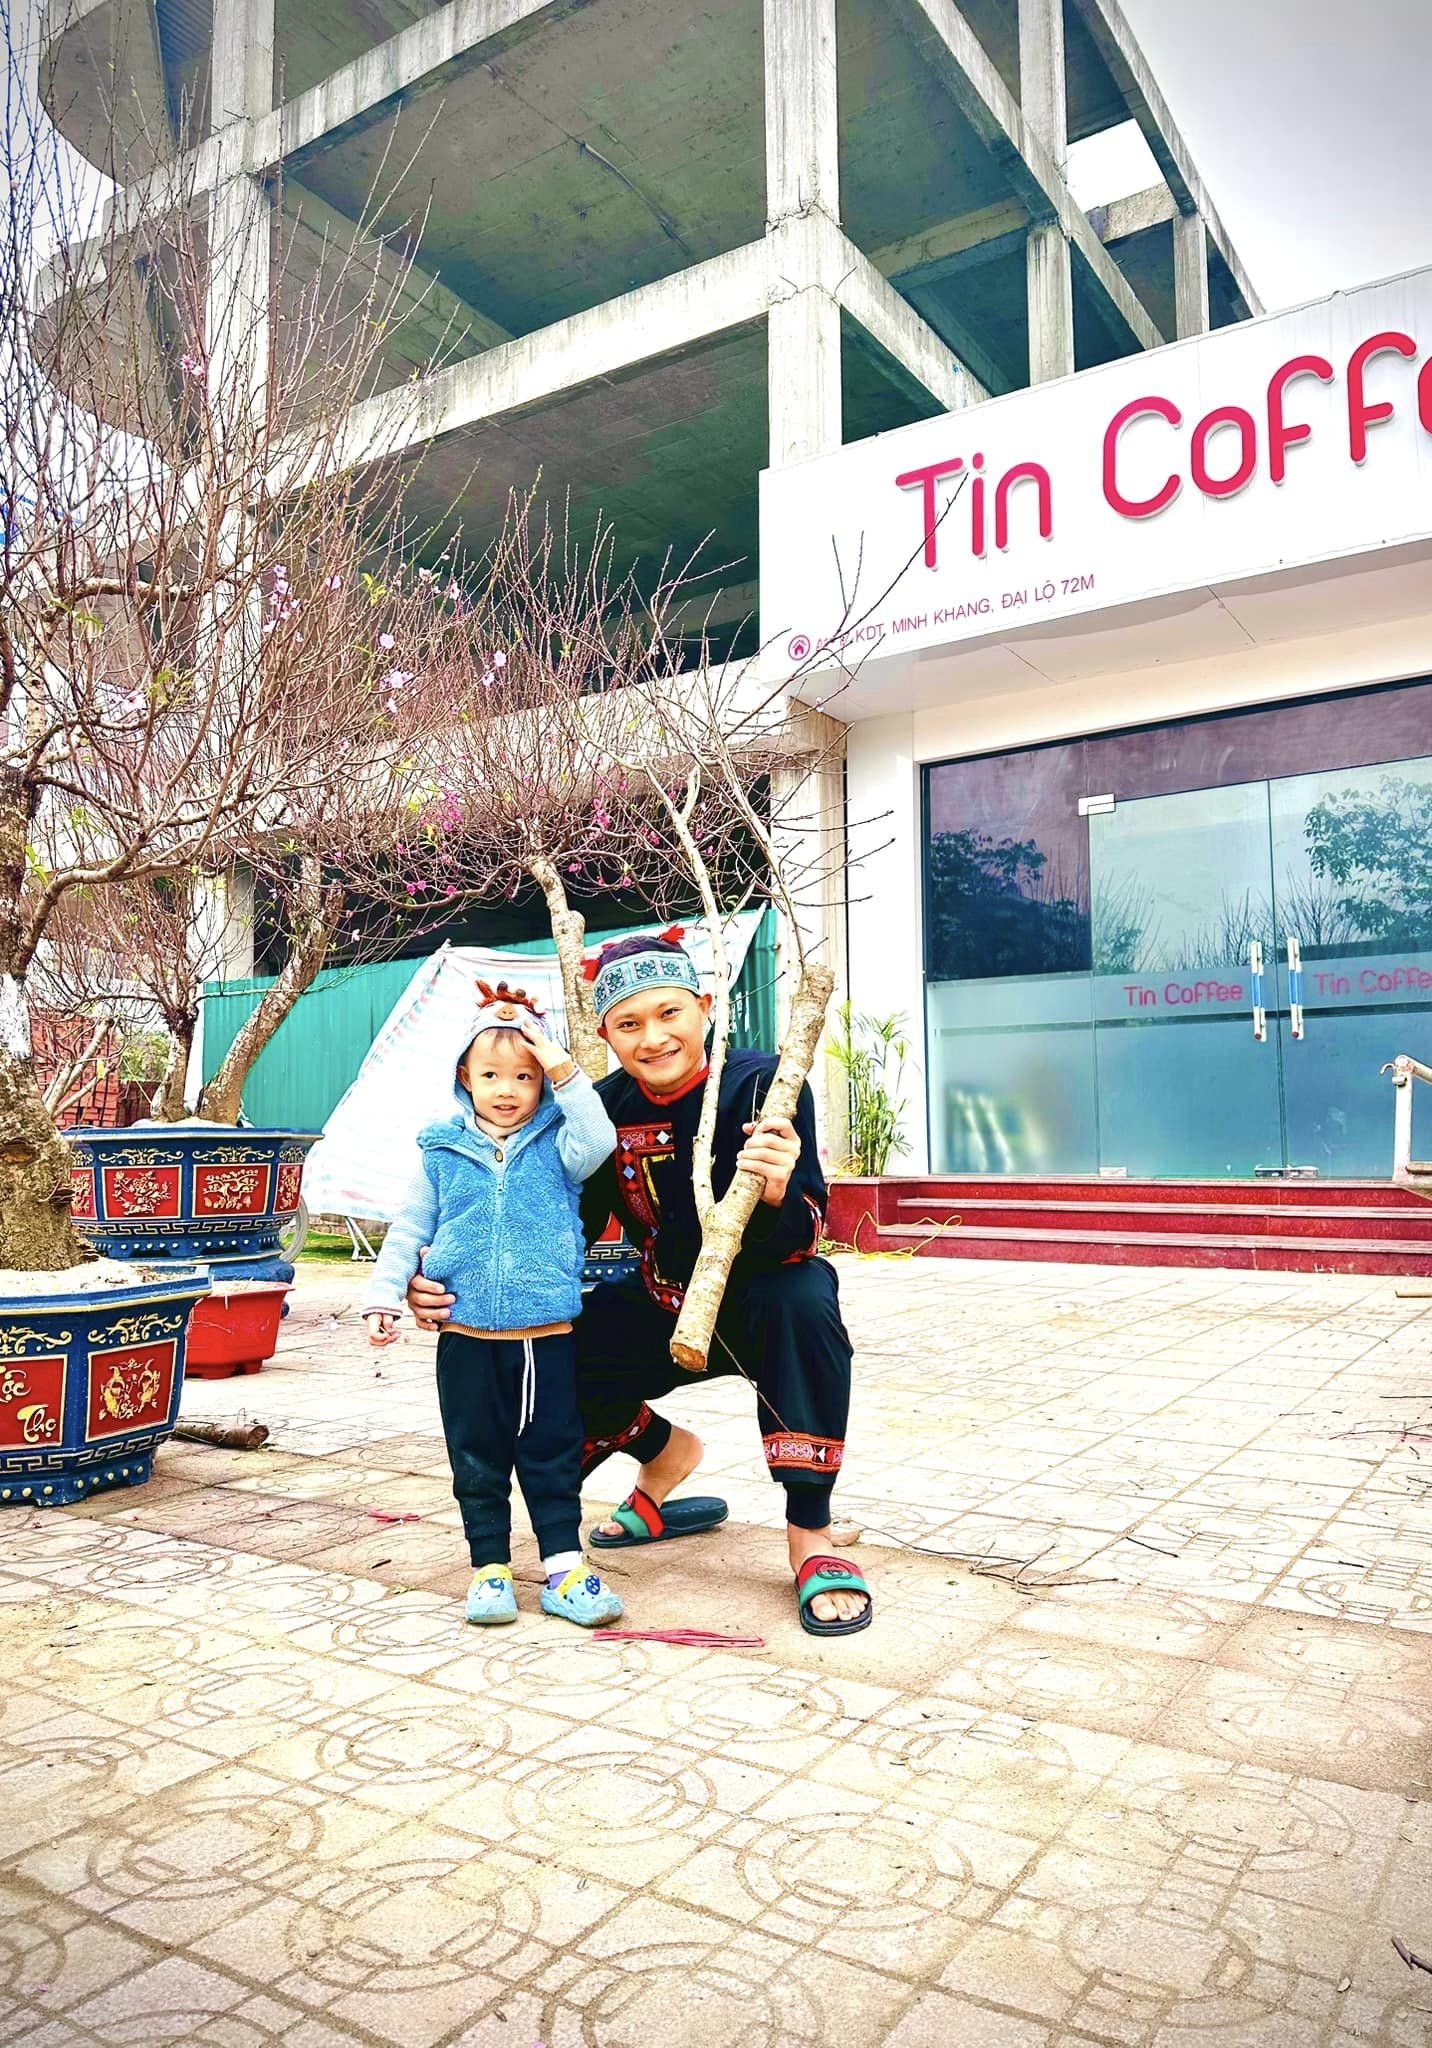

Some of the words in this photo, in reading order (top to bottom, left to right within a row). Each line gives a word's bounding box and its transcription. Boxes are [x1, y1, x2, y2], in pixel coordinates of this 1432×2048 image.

[895, 452, 1053, 569] Tin
[1103, 331, 1432, 518] Coff
[892, 614, 928, 635] MINH
[1001, 589, 1028, 609] ĐẠI
[1034, 579, 1056, 602] LỘ
[1061, 573, 1095, 596] 72M
[1124, 985, 1156, 1006] Tin
[1164, 980, 1243, 1005] Coffee
[1312, 972, 1350, 996] Tin
[0, 1365, 31, 1403] ộc
